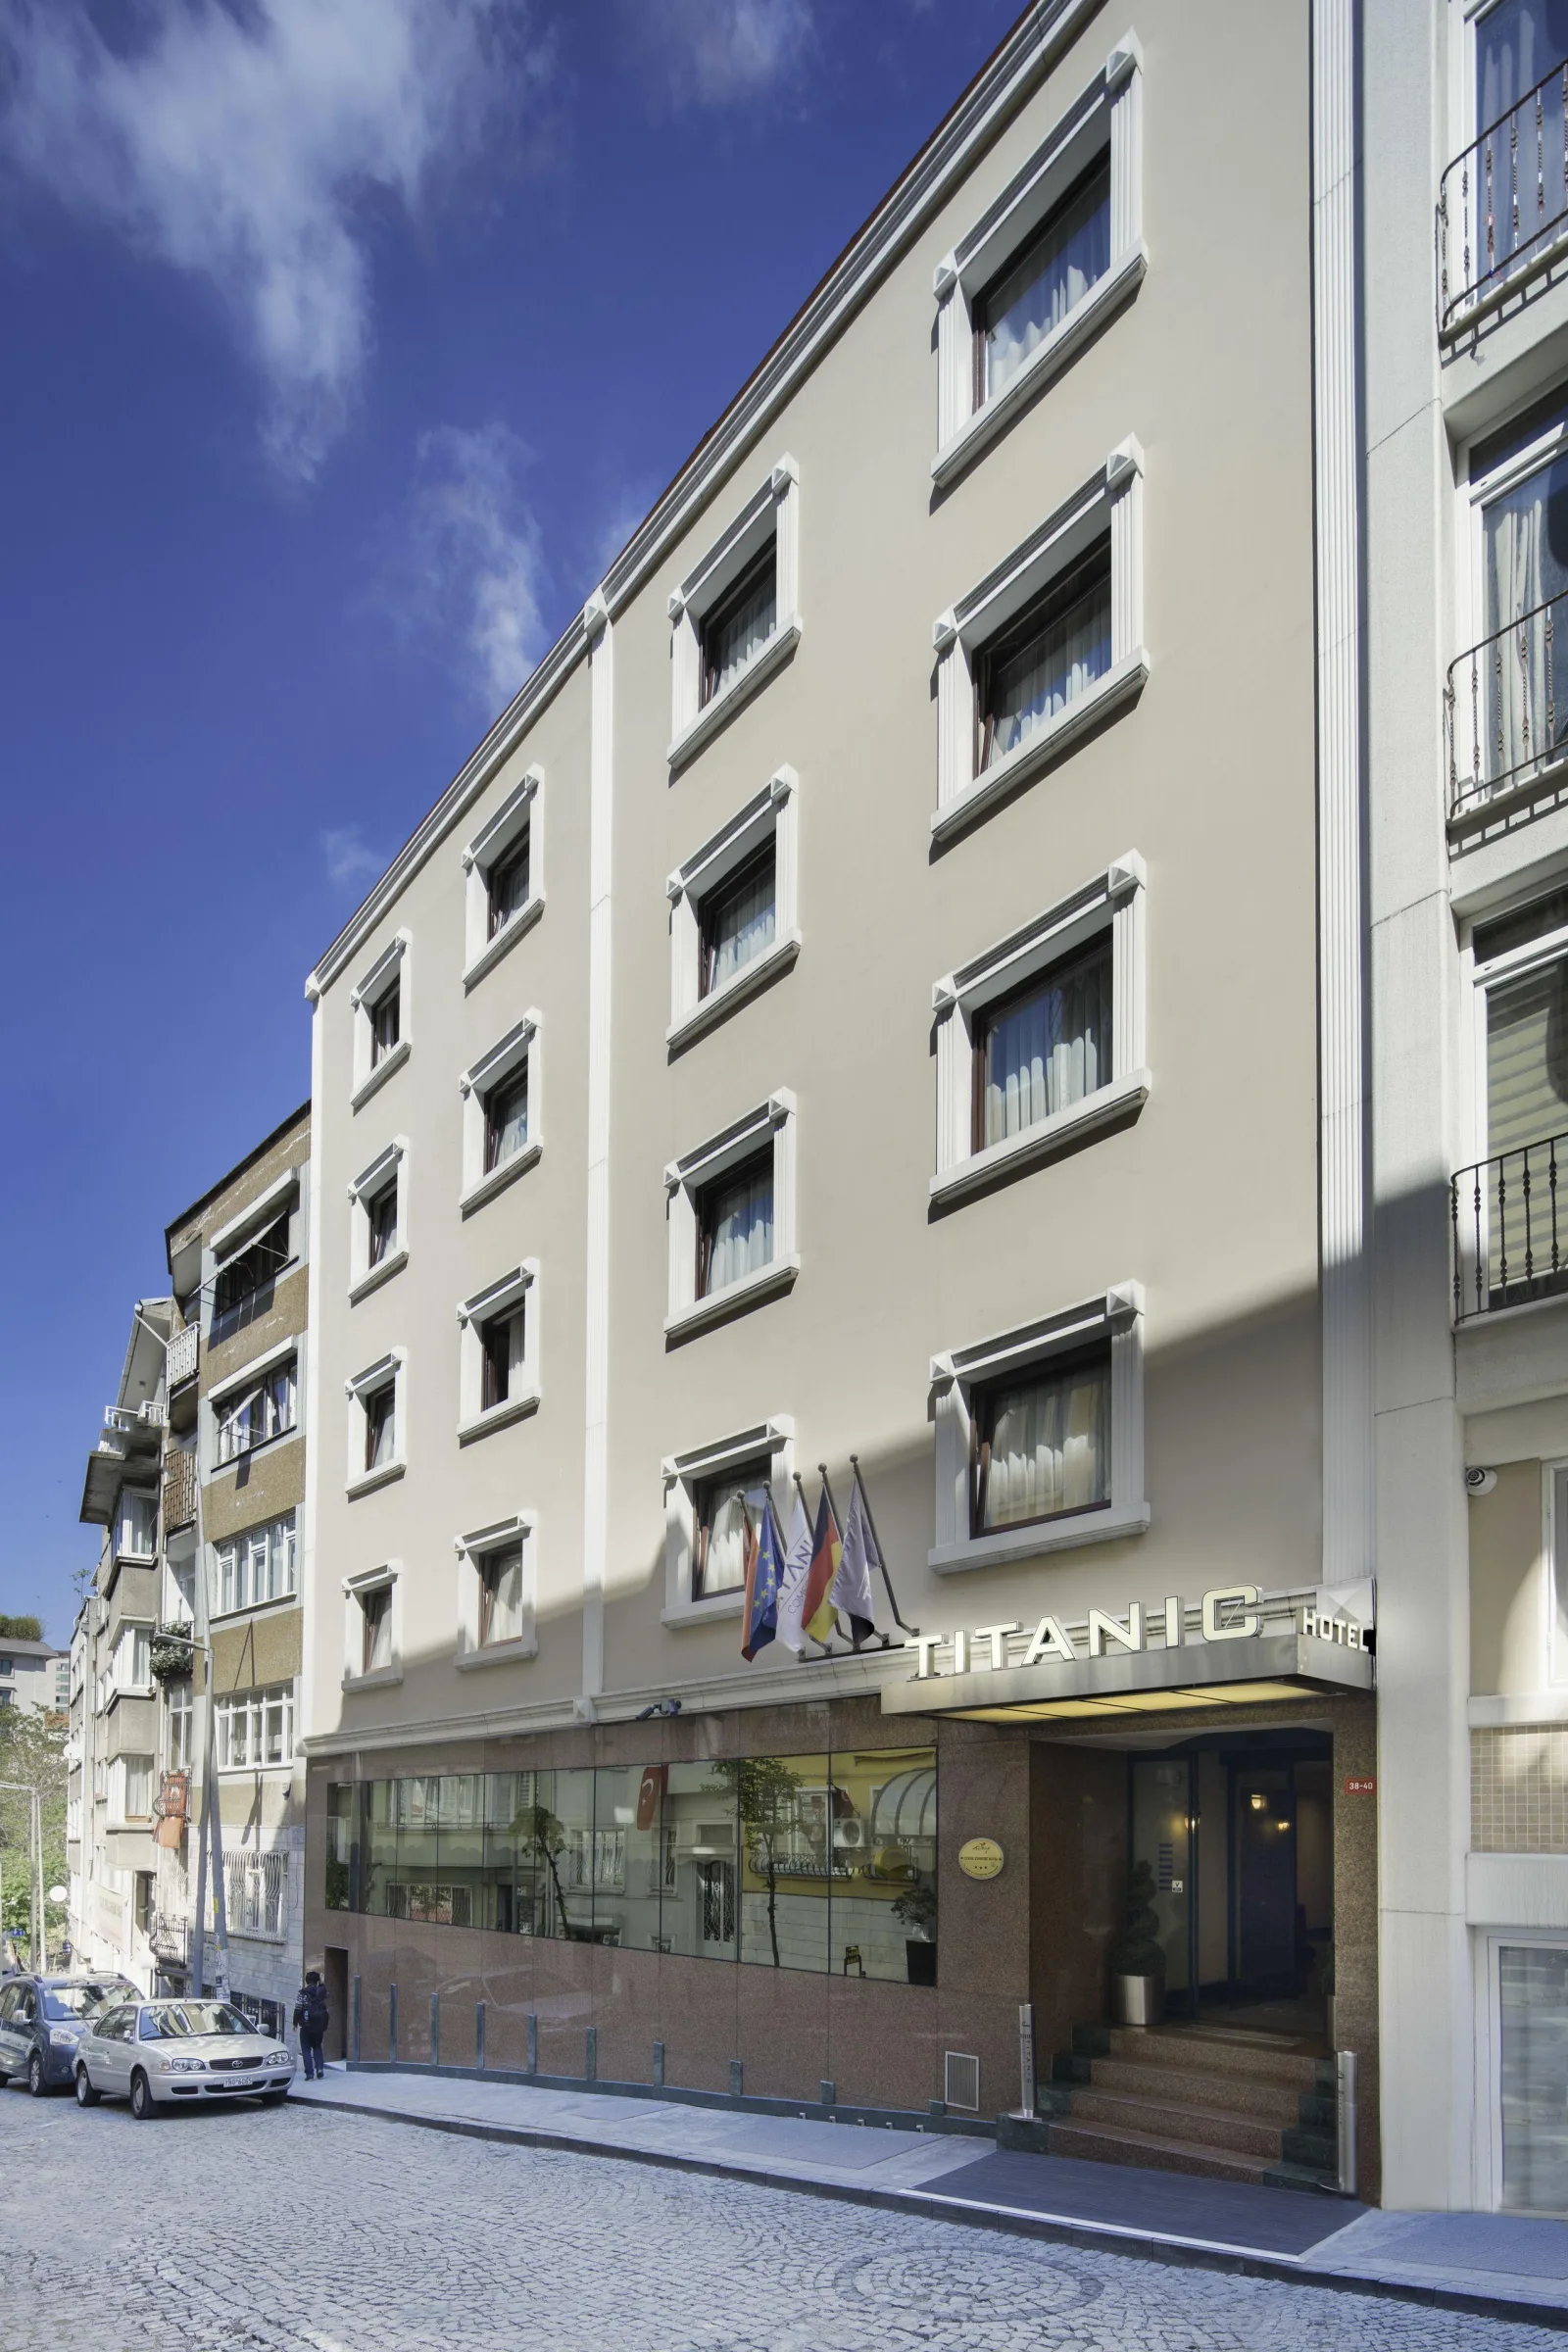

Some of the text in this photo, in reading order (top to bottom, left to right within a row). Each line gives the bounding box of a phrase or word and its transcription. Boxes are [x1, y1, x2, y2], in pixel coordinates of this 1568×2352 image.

[906, 1584, 1264, 1679] TITANIC
[1302, 1606, 1369, 1652] HOTEL
[1348, 1782, 1373, 1790] 38-40
